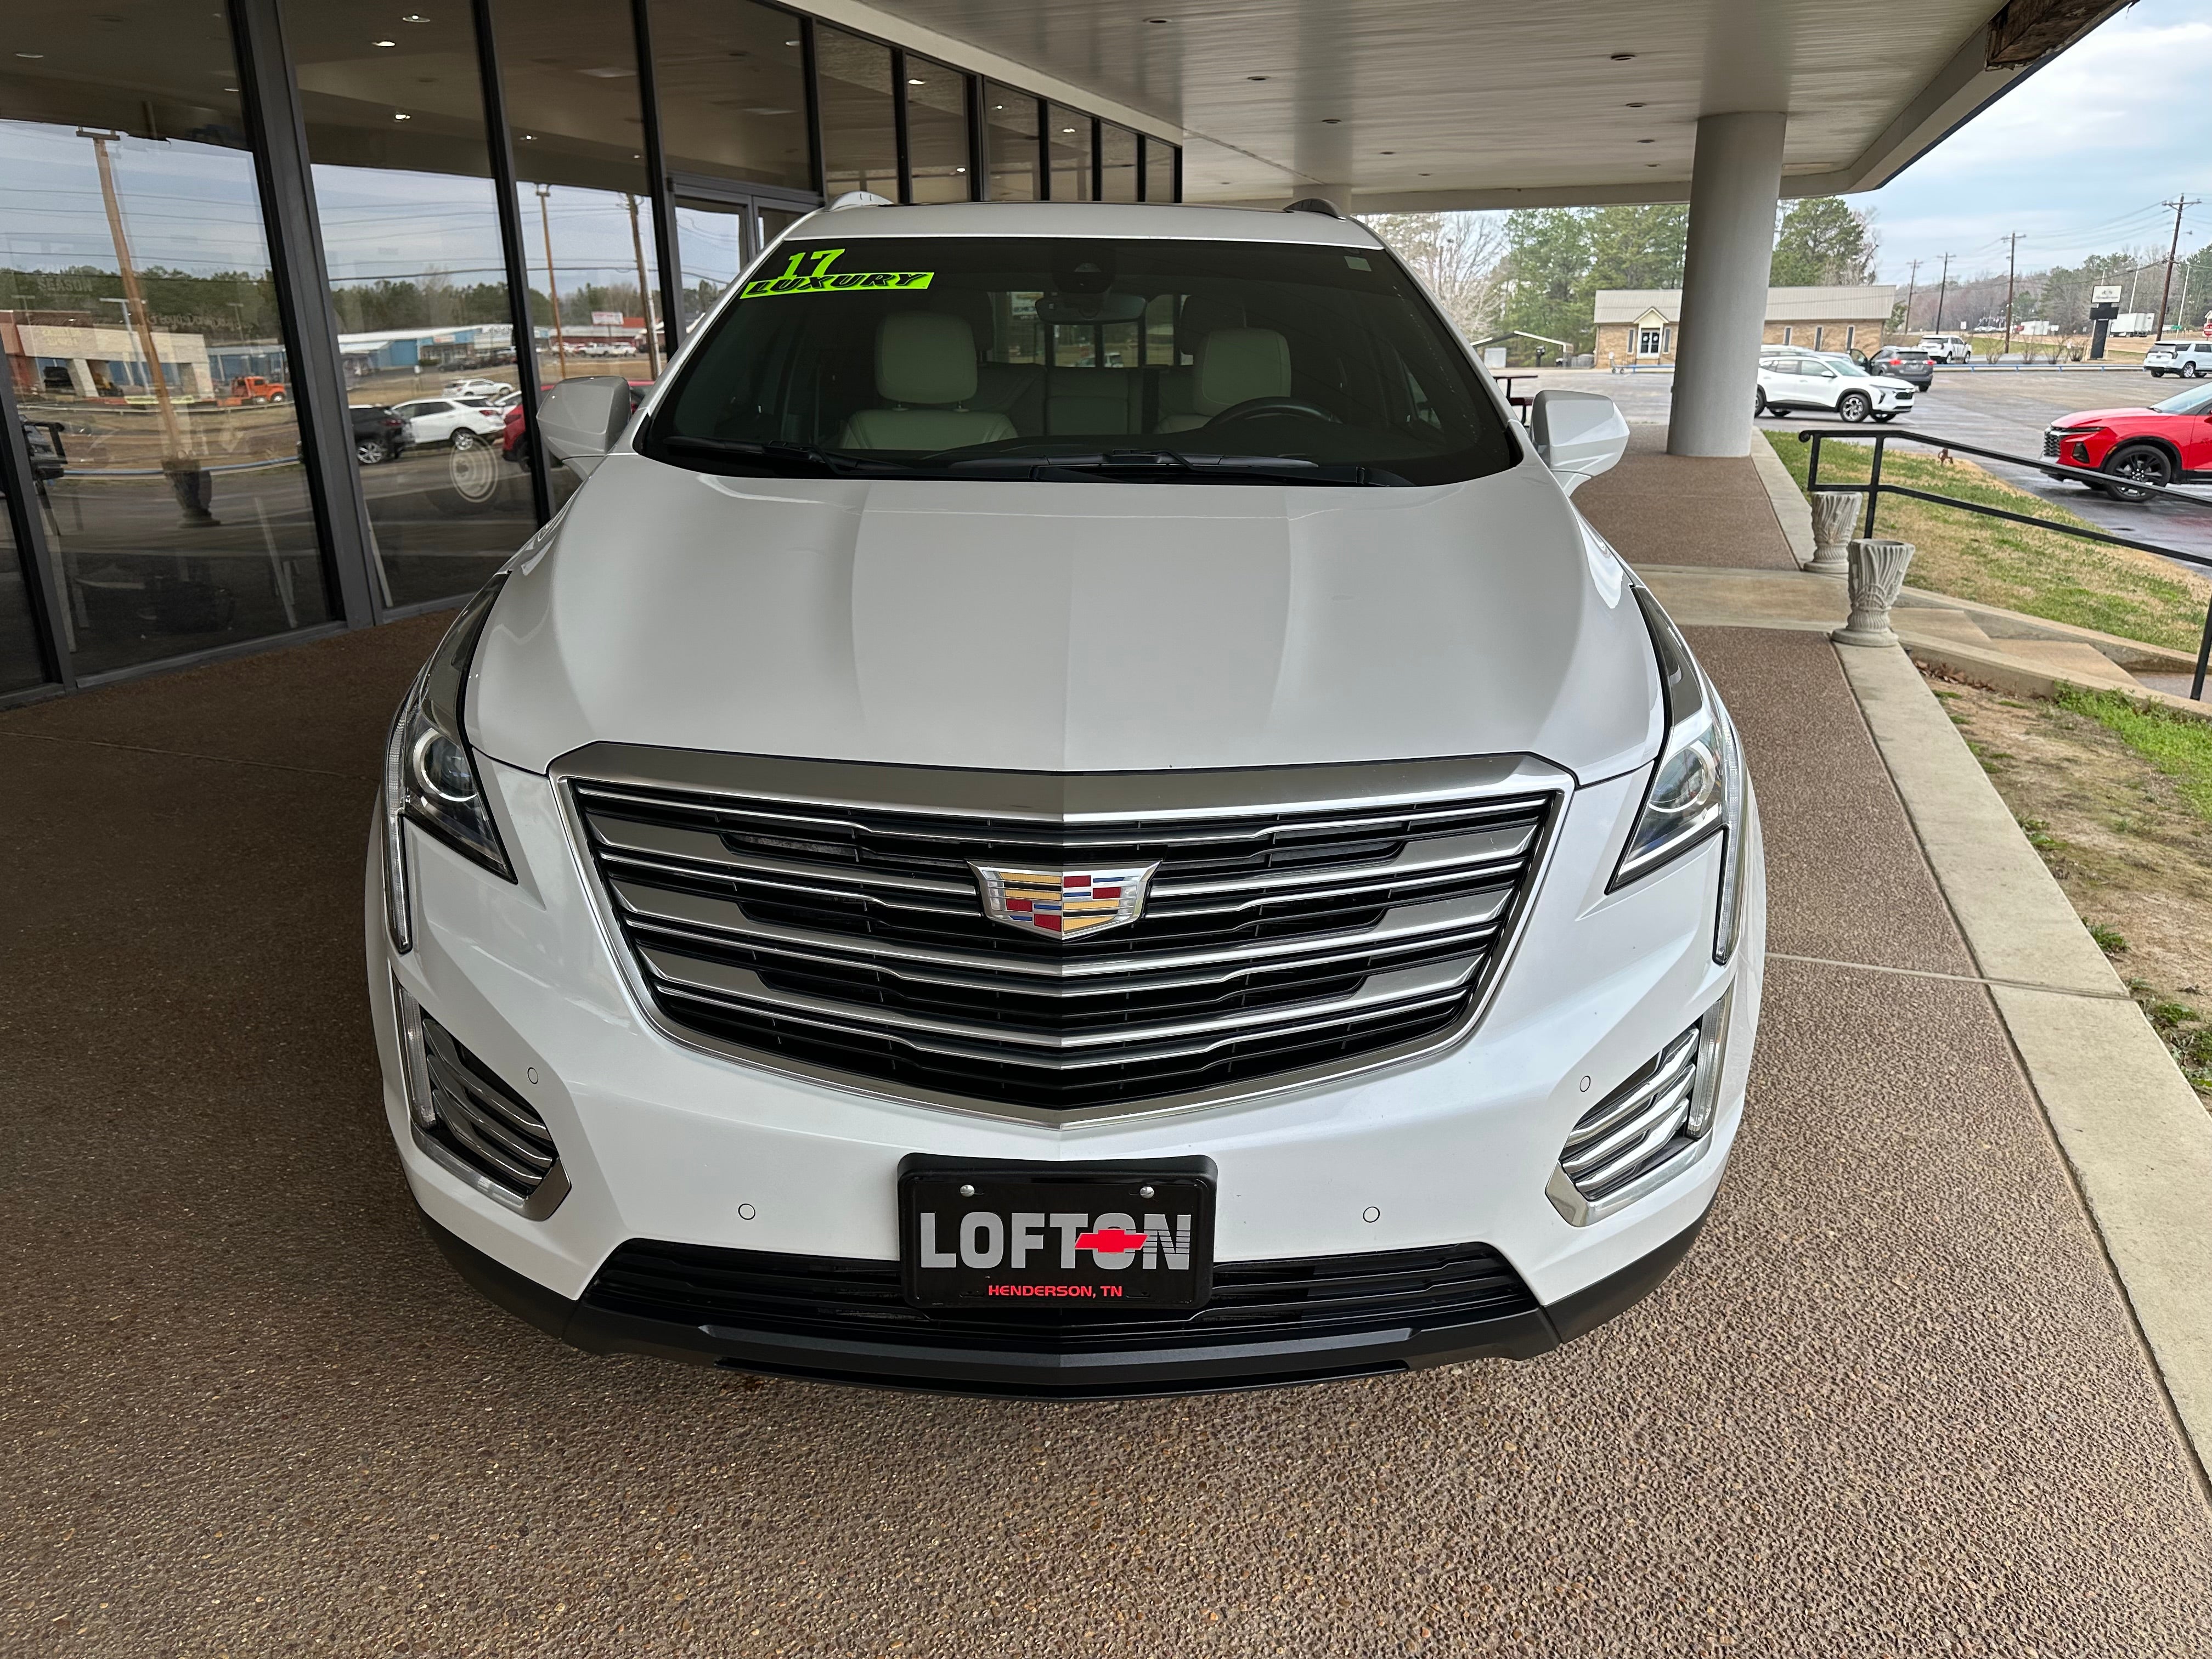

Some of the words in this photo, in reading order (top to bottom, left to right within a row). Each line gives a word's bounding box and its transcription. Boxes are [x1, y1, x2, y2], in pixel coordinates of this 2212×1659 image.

[778, 248, 845, 279] 17
[746, 273, 927, 296] LUXURY
[920, 1211, 1192, 1270] LOFTON
[988, 1284, 1096, 1299] HENDERSON,
[1100, 1285, 1122, 1297] TN
